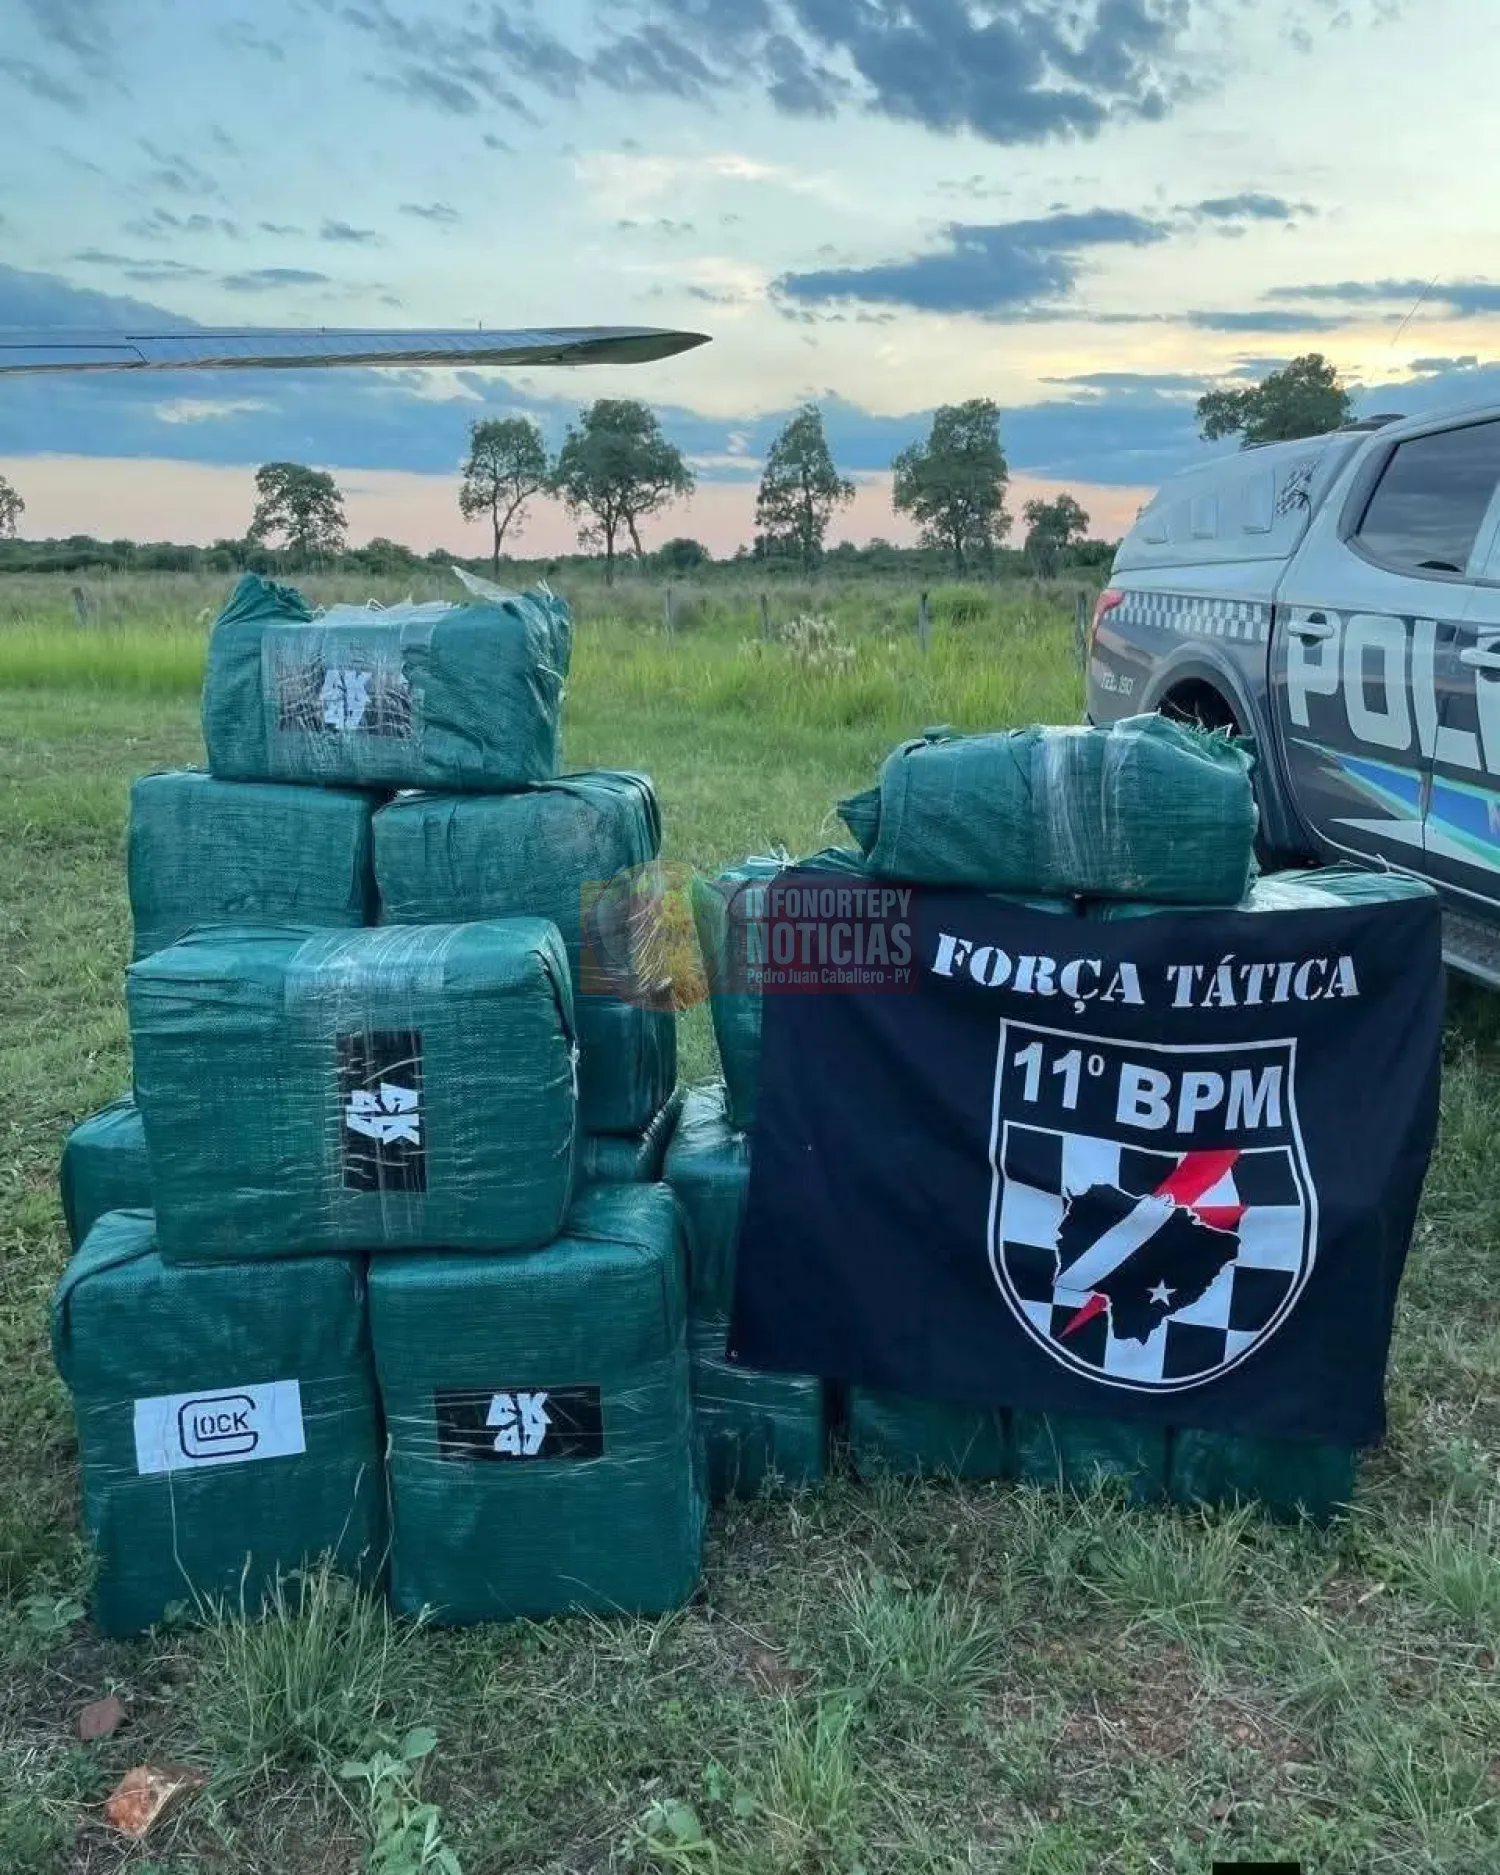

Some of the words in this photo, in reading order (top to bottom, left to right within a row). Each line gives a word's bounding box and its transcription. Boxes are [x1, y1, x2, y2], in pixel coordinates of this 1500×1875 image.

[931, 932, 1145, 1014] FORÇA
[1166, 954, 1361, 1008] TÁTICA
[1116, 1063, 1282, 1134] BPM
